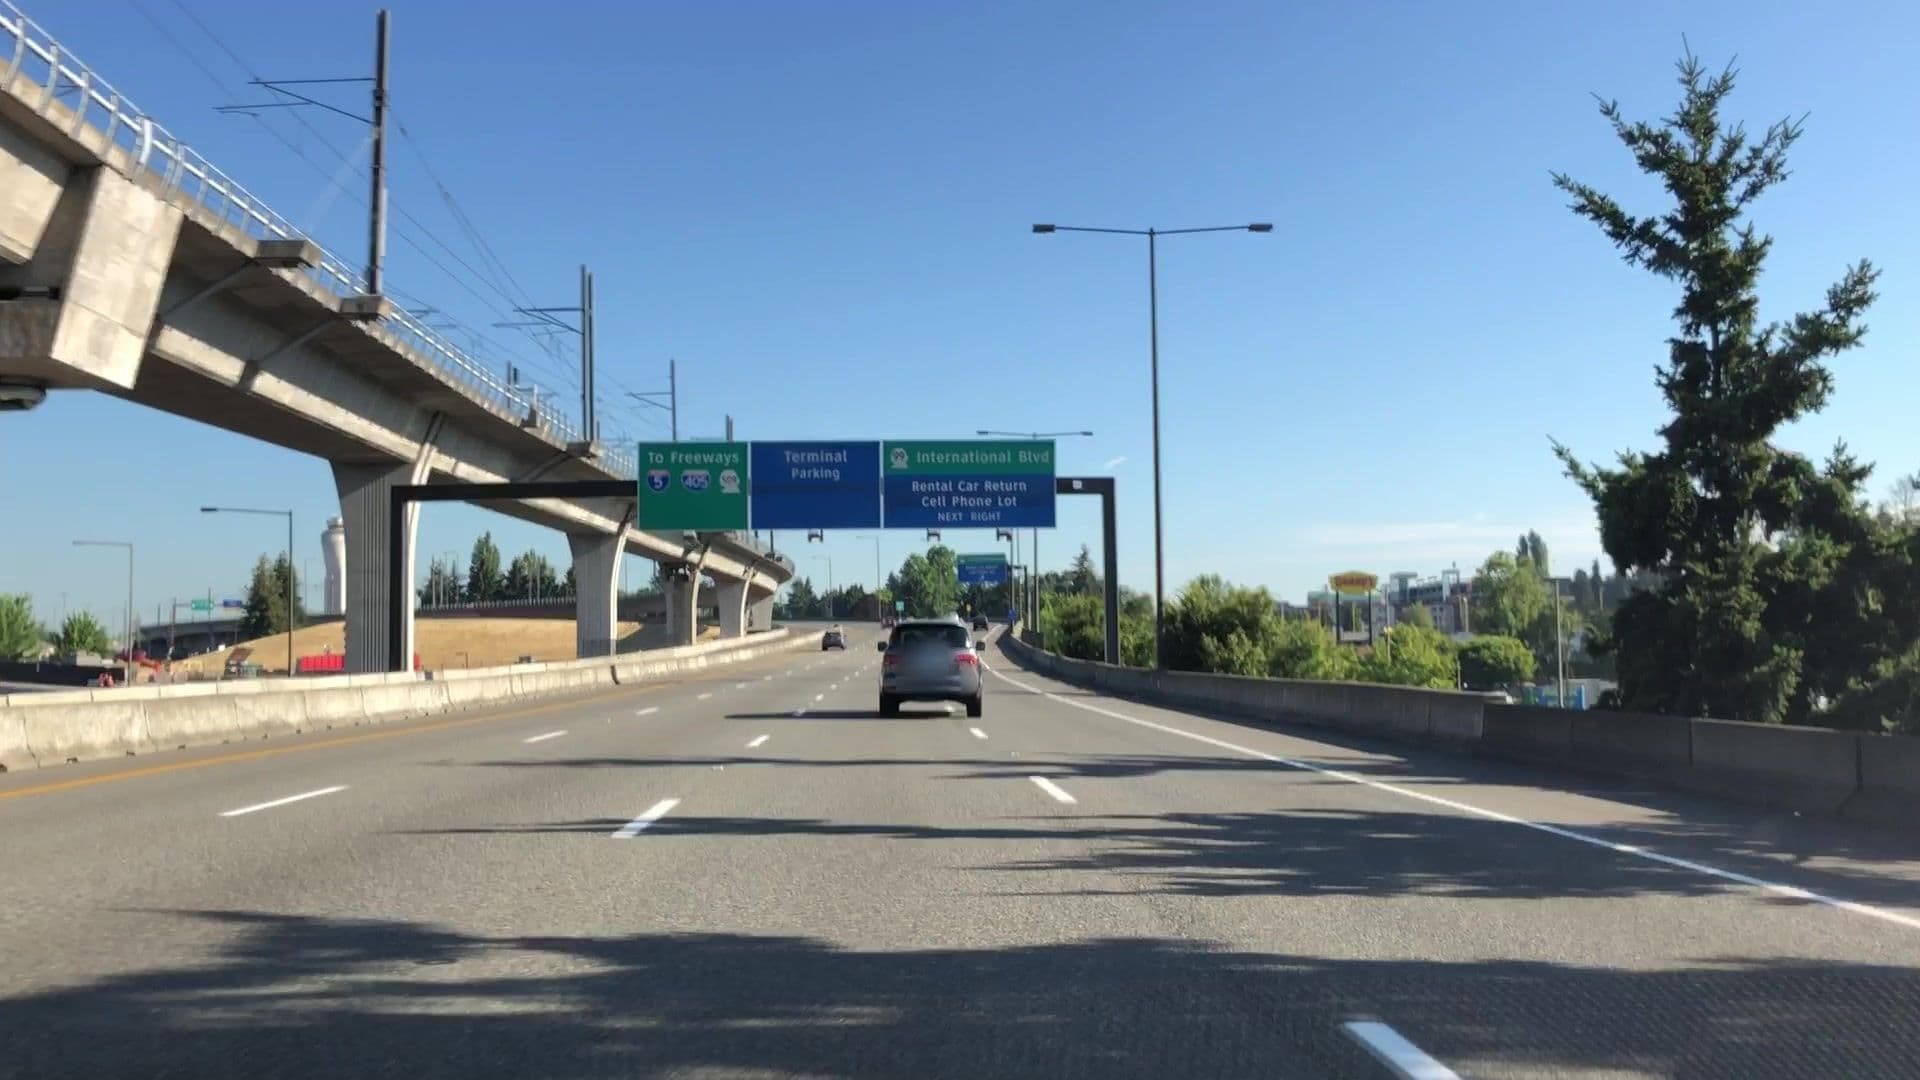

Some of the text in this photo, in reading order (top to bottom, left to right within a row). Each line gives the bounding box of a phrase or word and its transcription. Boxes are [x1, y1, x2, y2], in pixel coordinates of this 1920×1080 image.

[648, 451, 739, 466] To Freeways
[783, 449, 848, 463] Terminal
[916, 449, 1050, 464] International Blvd
[791, 467, 841, 481] Parking
[653, 476, 663, 489] 5
[684, 476, 708, 489] 405
[911, 480, 1027, 492] Rental Car Return
[921, 495, 1017, 507] Cell Phone Lot
[937, 511, 1001, 522] NEXT RIGHT
